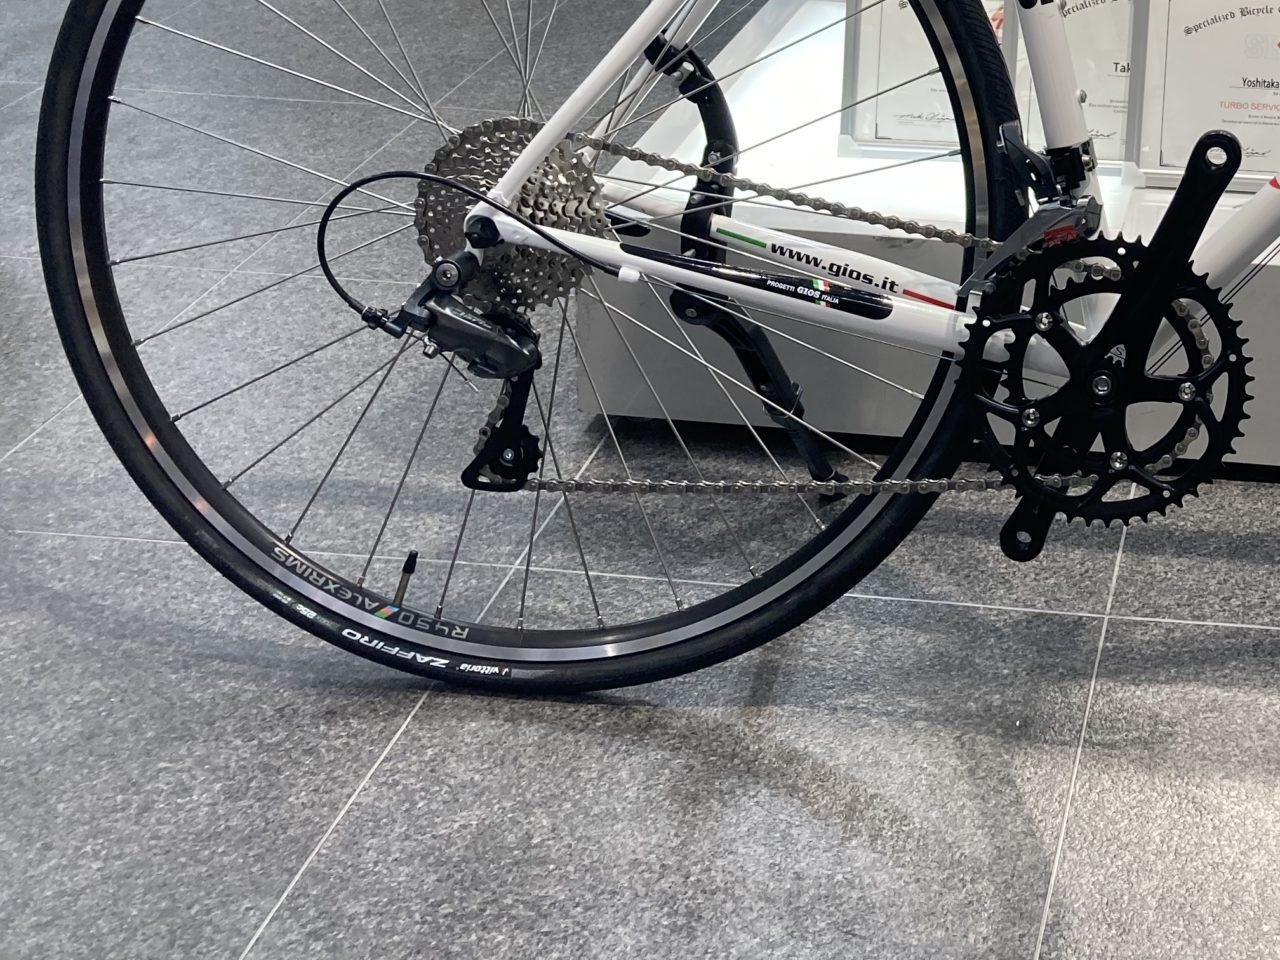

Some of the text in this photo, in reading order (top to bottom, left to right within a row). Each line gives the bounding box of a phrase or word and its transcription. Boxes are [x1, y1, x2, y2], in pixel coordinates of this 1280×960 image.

[1183, 10, 1236, 38] Specialized
[1239, 5, 1274, 18] Bicycle
[1242, 77, 1280, 89] Yoshitaka
[1219, 101, 1249, 110] TURBO
[771, 242, 900, 293] www.gios.it
[767, 279, 839, 305] PROGETTI GIOS ITALIA
[271, 546, 470, 640] R450 ALEXRIMS
[342, 628, 450, 669] ZAFFIRO
[459, 662, 501, 676] vittoria
